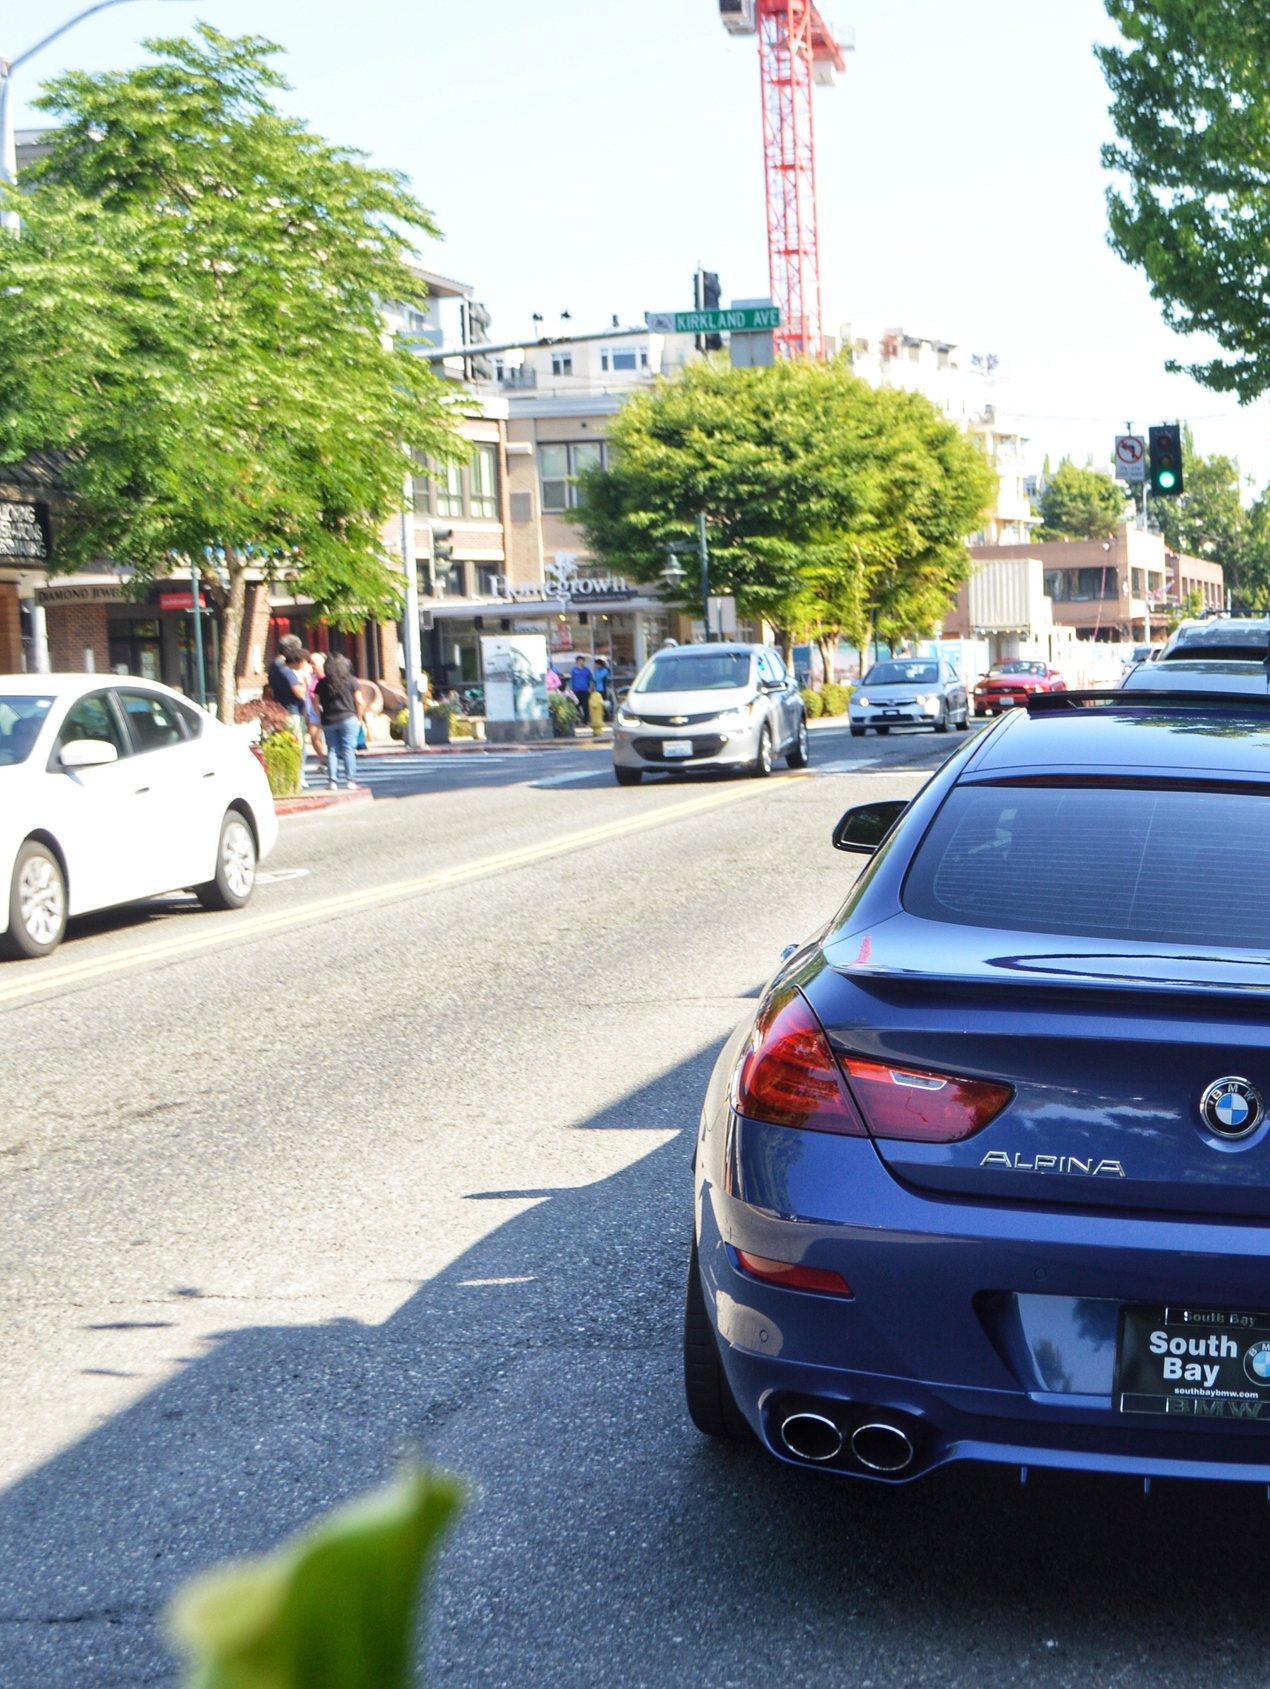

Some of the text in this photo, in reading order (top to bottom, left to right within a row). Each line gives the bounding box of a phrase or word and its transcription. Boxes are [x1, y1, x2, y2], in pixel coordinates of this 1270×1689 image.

[677, 309, 779, 331] KIRKLAND AVE
[39, 587, 89, 601] DIAMOND
[488, 574, 629, 602] Homegrown
[1211, 1083, 1255, 1101] BMW
[979, 1150, 1126, 1178] ALPINA
[1183, 1311, 1256, 1327] South Bay
[1149, 1330, 1238, 1358] South
[1162, 1357, 1220, 1387] Bay
[1174, 1387, 1259, 1399] southbaybmw.com
[1166, 1397, 1263, 1418] BMW
